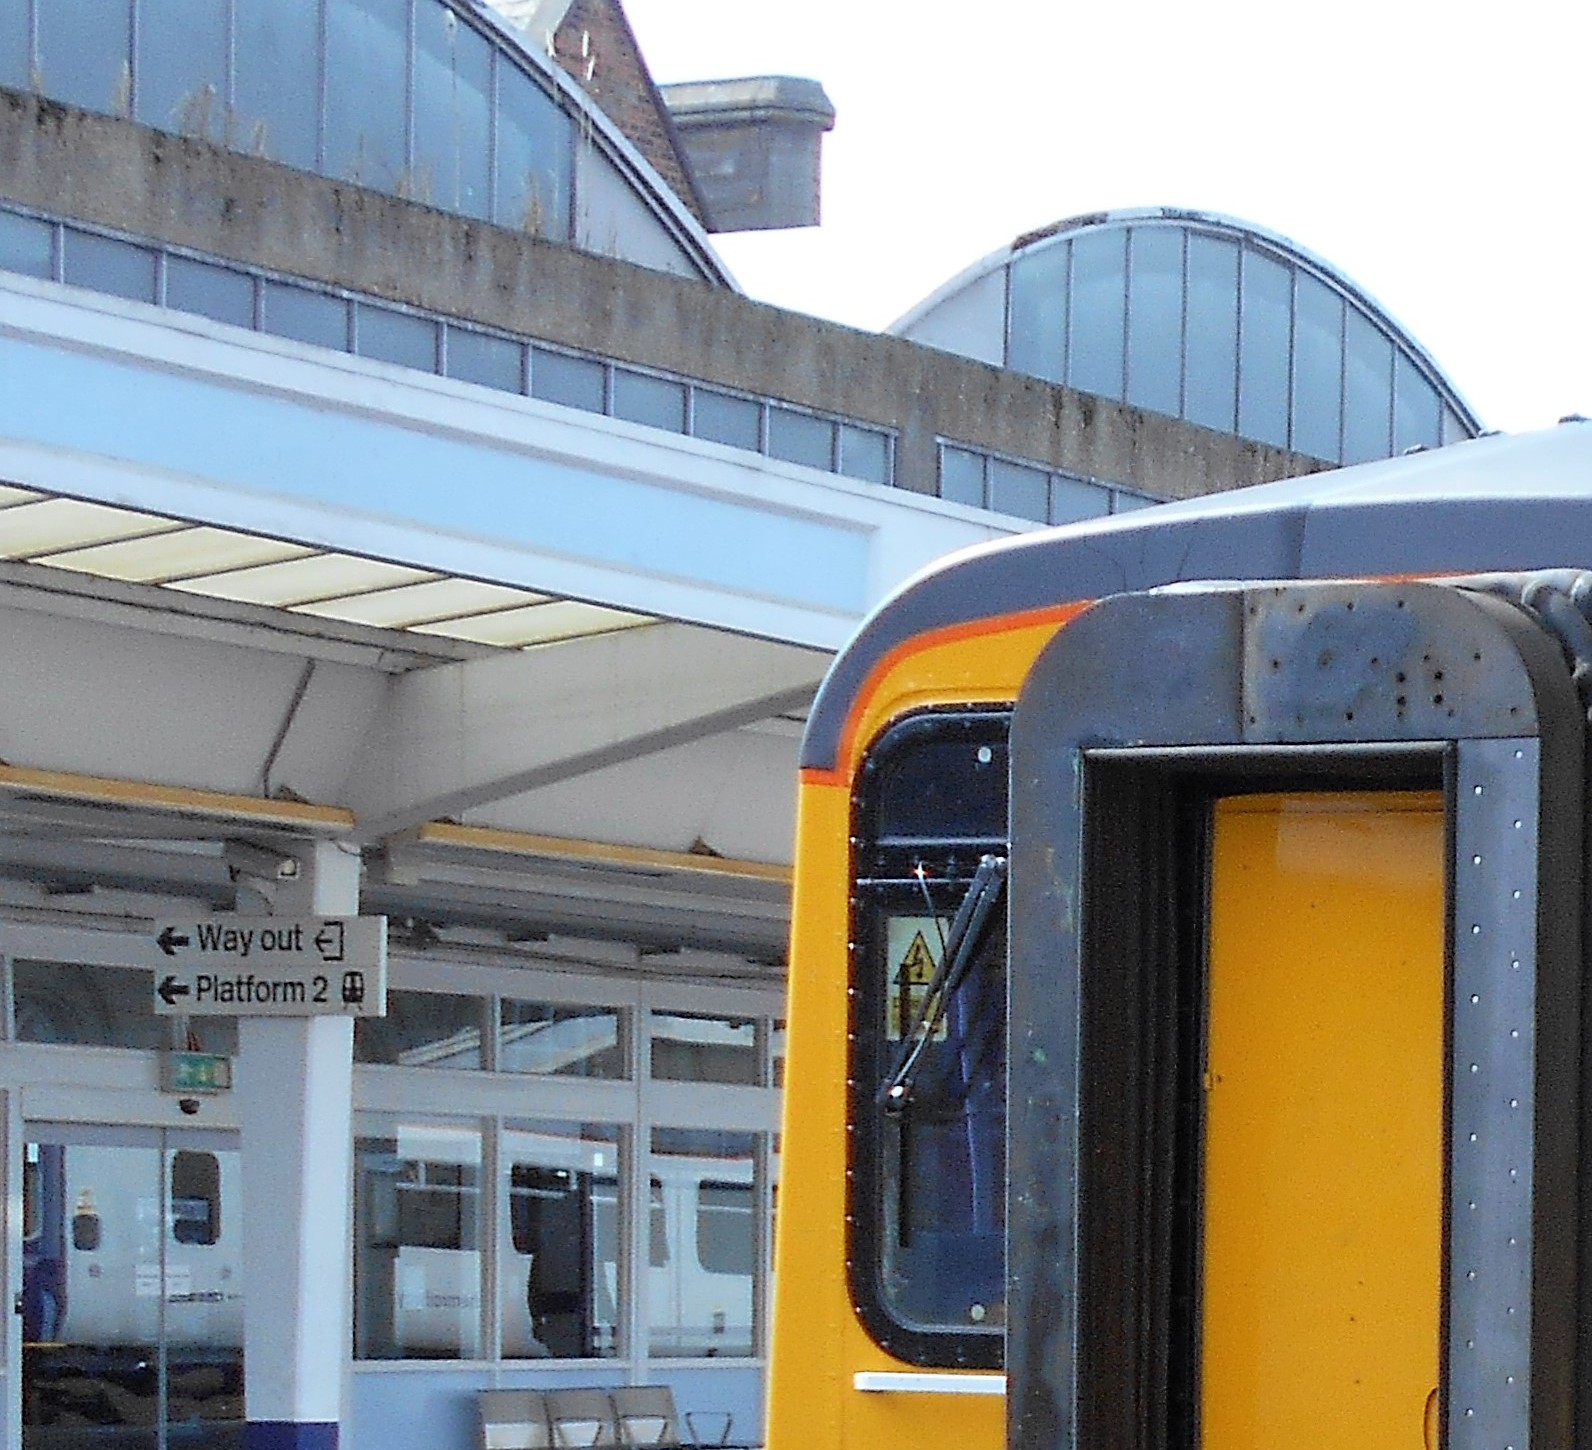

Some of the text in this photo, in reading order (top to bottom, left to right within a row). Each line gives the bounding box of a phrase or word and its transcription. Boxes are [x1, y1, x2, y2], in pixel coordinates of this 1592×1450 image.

[197, 923, 303, 956] Way out
[197, 974, 328, 1002] Platform 2
